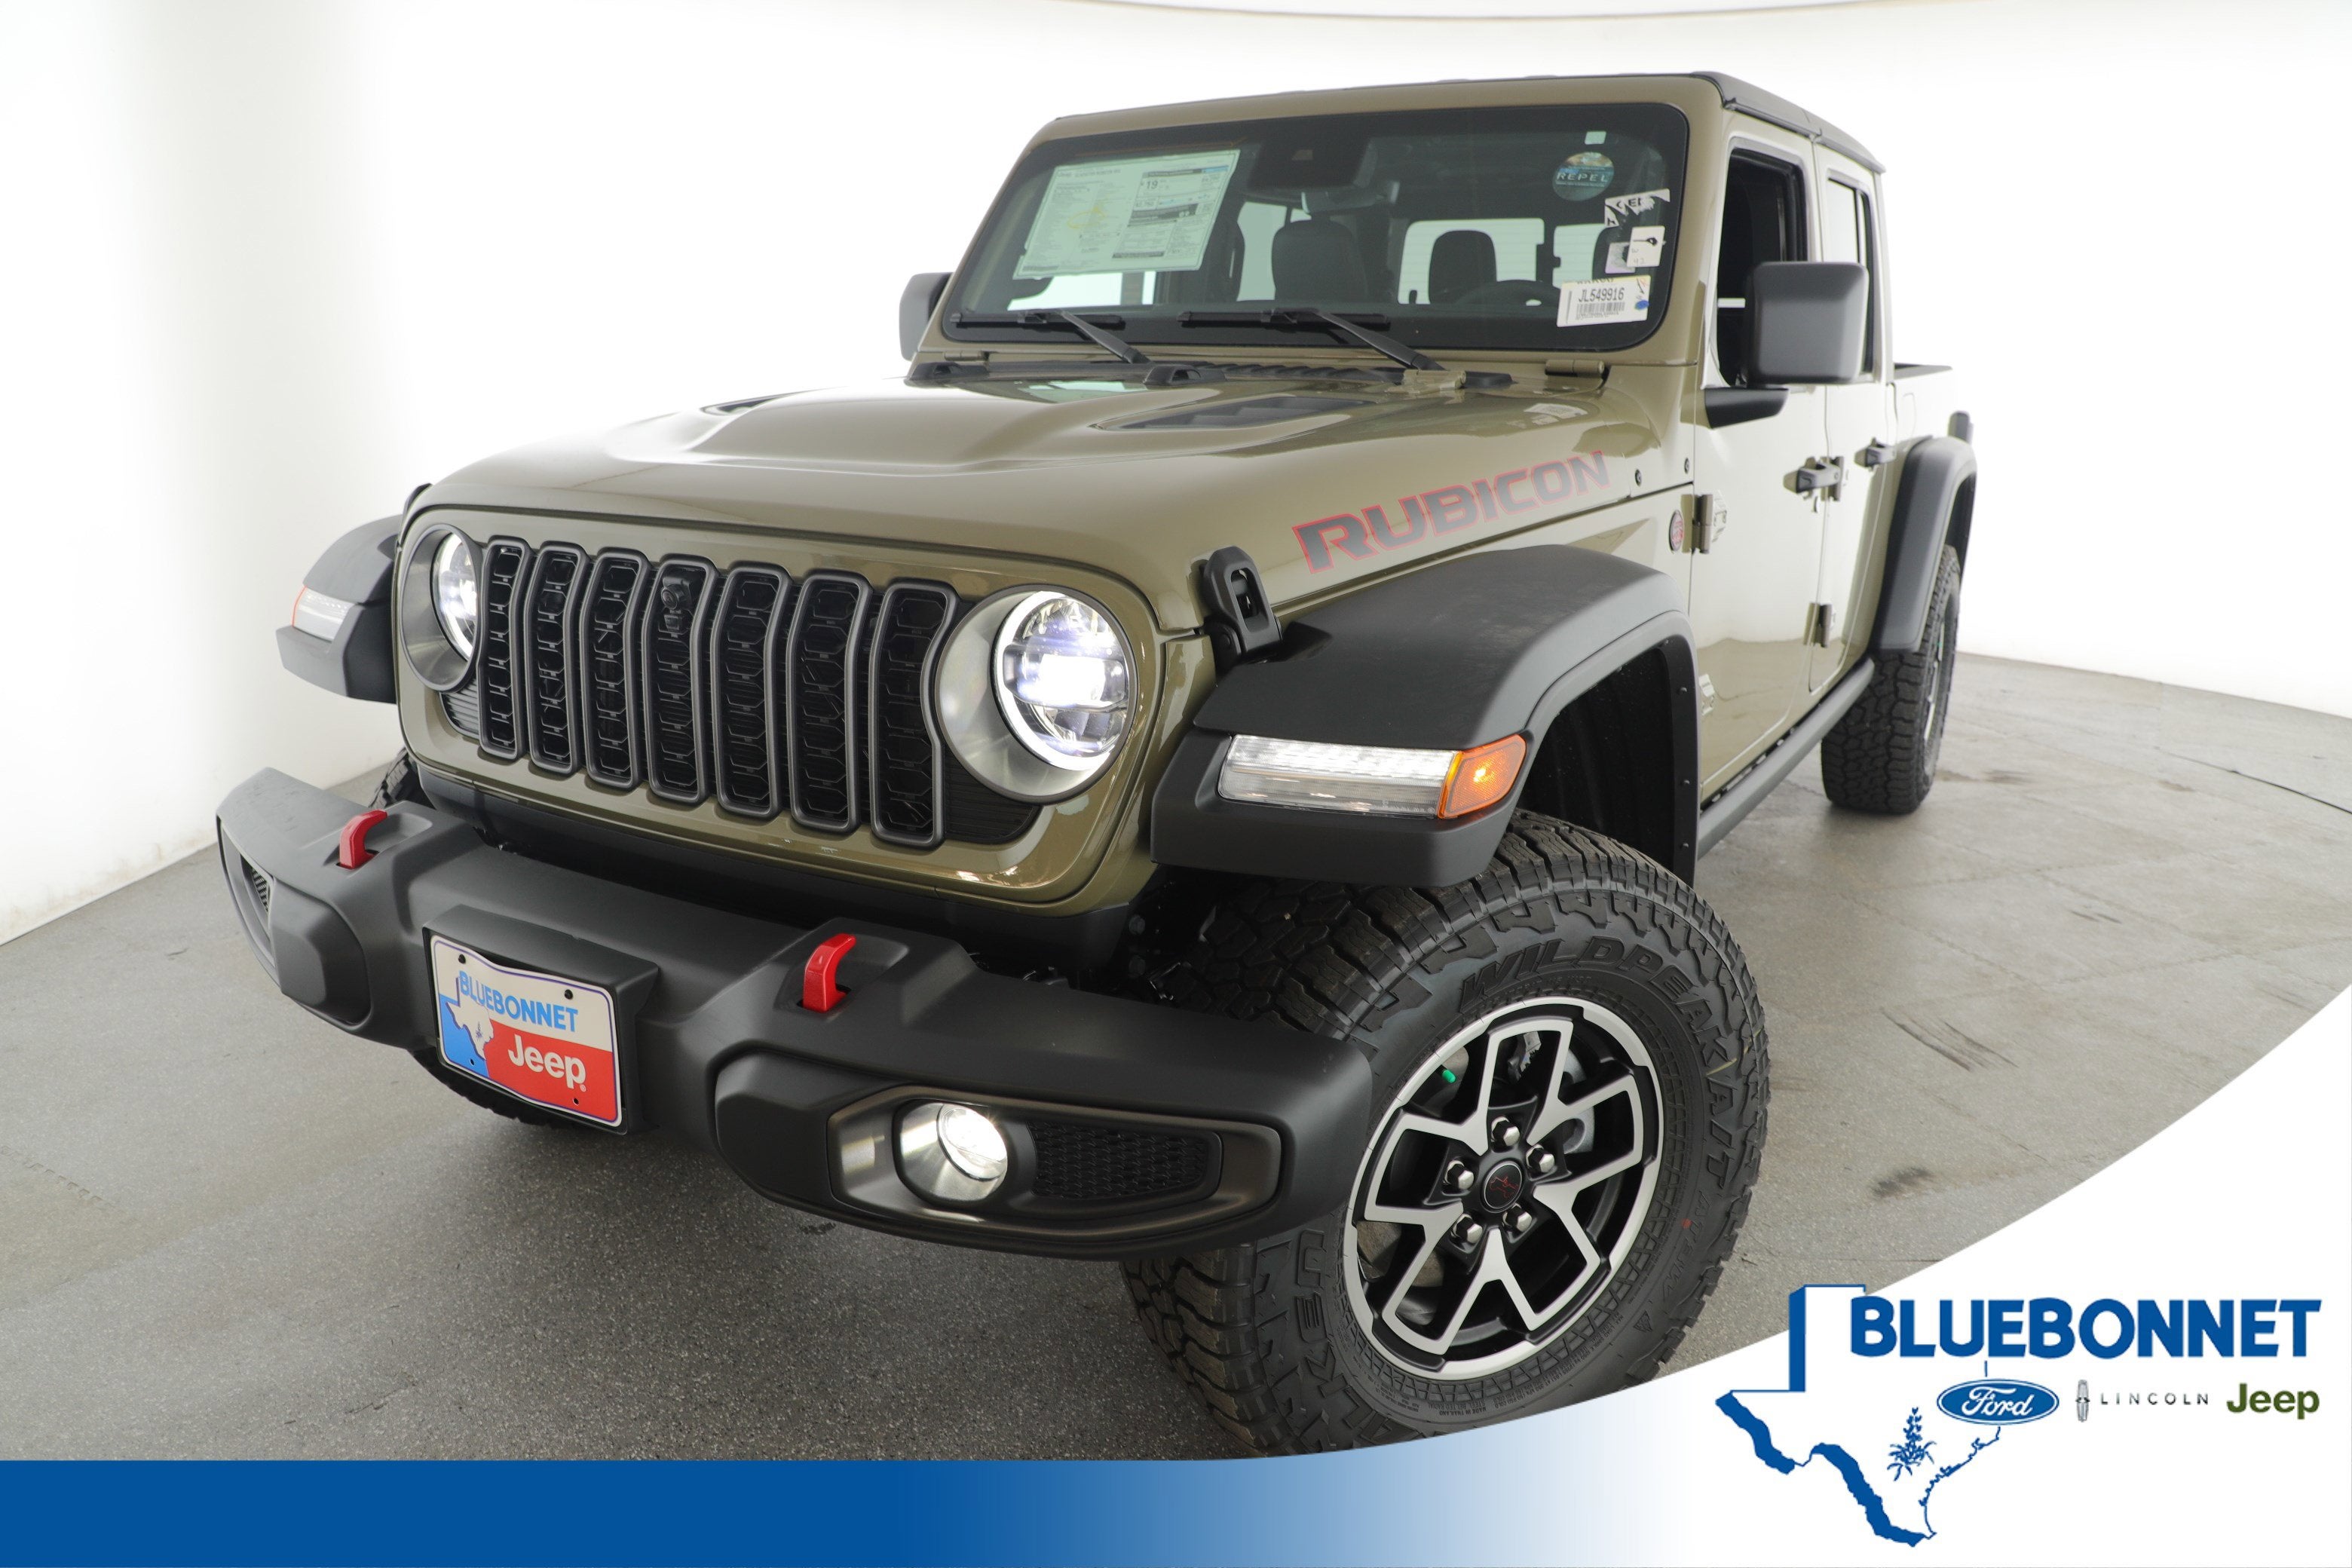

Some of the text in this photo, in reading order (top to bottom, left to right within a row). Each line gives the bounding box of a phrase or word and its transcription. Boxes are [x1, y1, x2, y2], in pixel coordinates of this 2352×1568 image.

[1557, 173, 1609, 182] REPEL
[1578, 287, 1625, 302] JL549916
[1292, 450, 1611, 574] RUBICON
[459, 970, 578, 1033] BLUEBONNET
[1459, 936, 1728, 1061] WILDPEAK
[507, 1034, 586, 1089] Jeep
[1294, 1229, 1423, 1437] ALKEN
